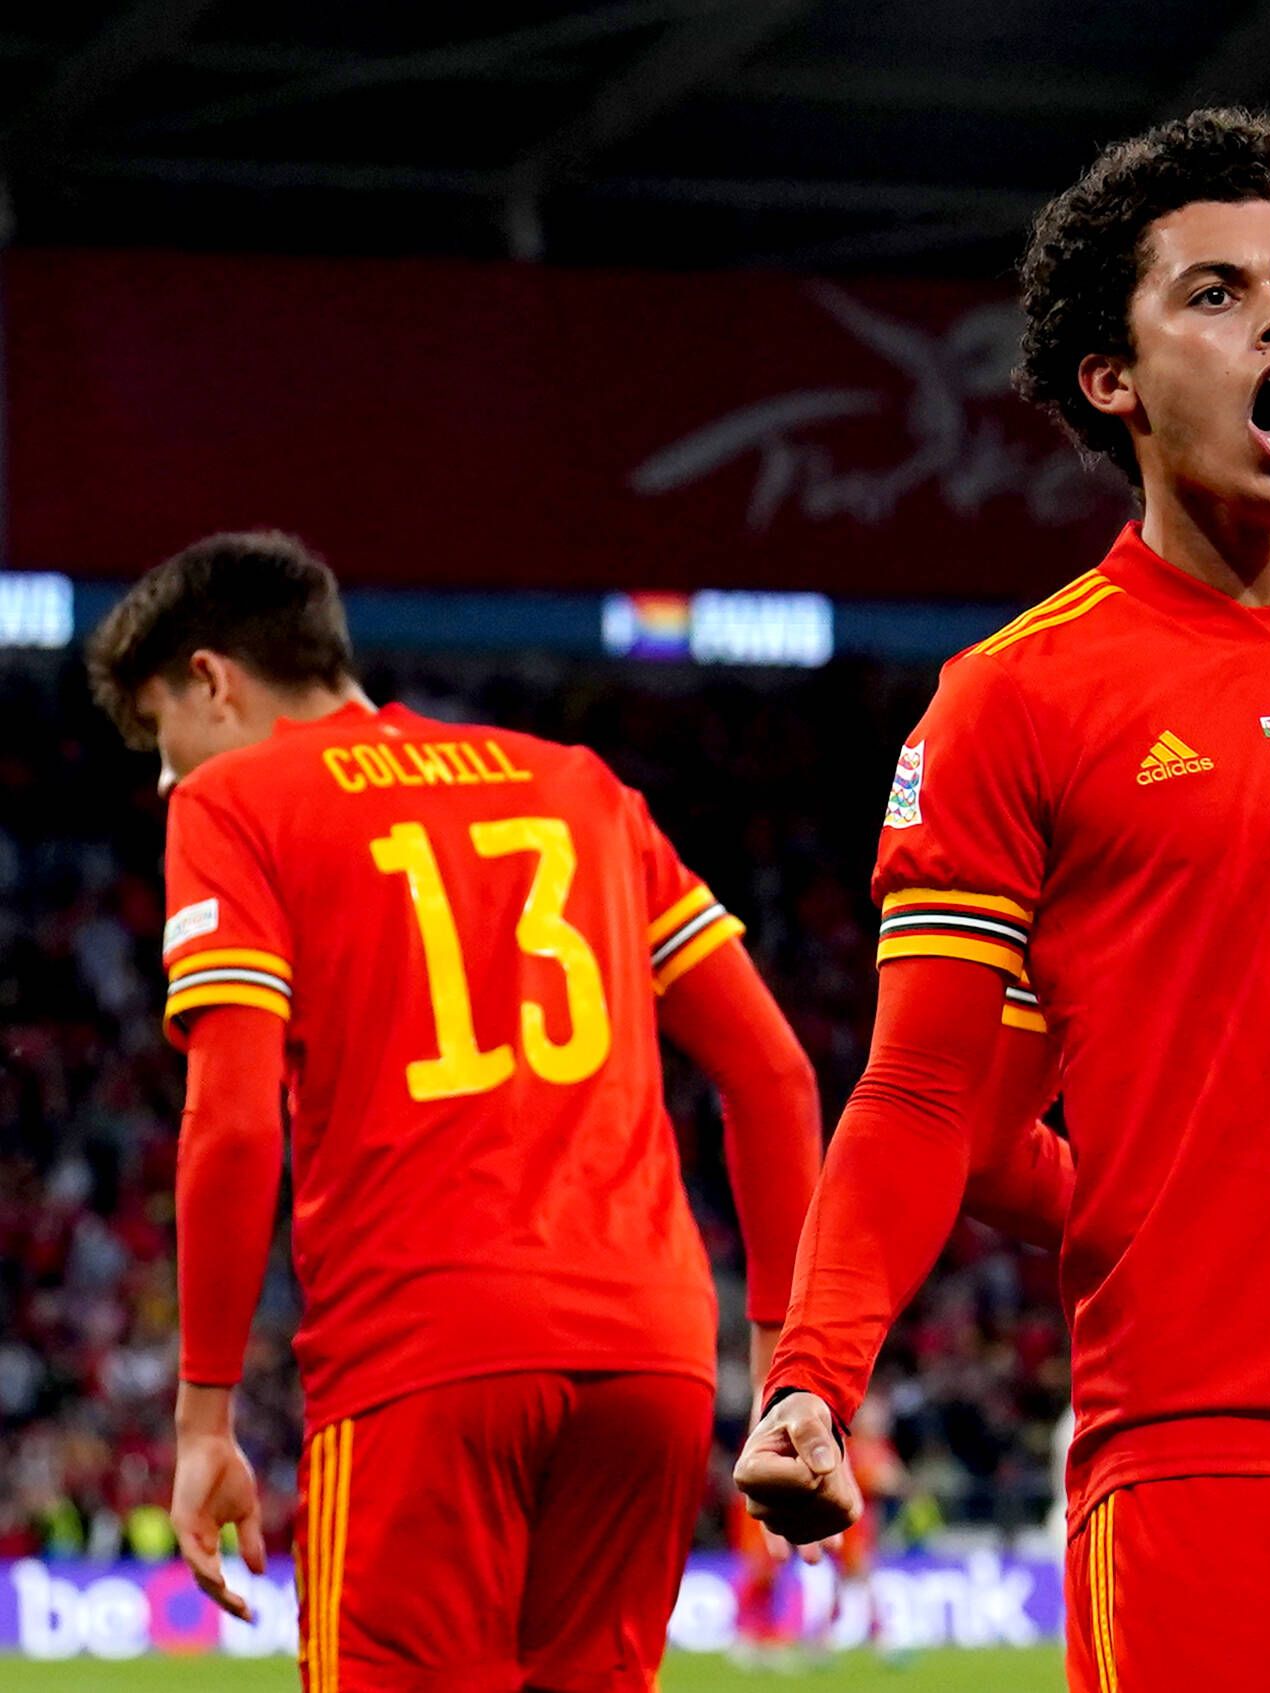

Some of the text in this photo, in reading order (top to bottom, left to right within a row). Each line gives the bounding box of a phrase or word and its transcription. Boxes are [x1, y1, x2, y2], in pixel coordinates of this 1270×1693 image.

[322, 740, 533, 793] COLWILL
[1136, 757, 1214, 785] adidas
[370, 816, 611, 1101] 13
